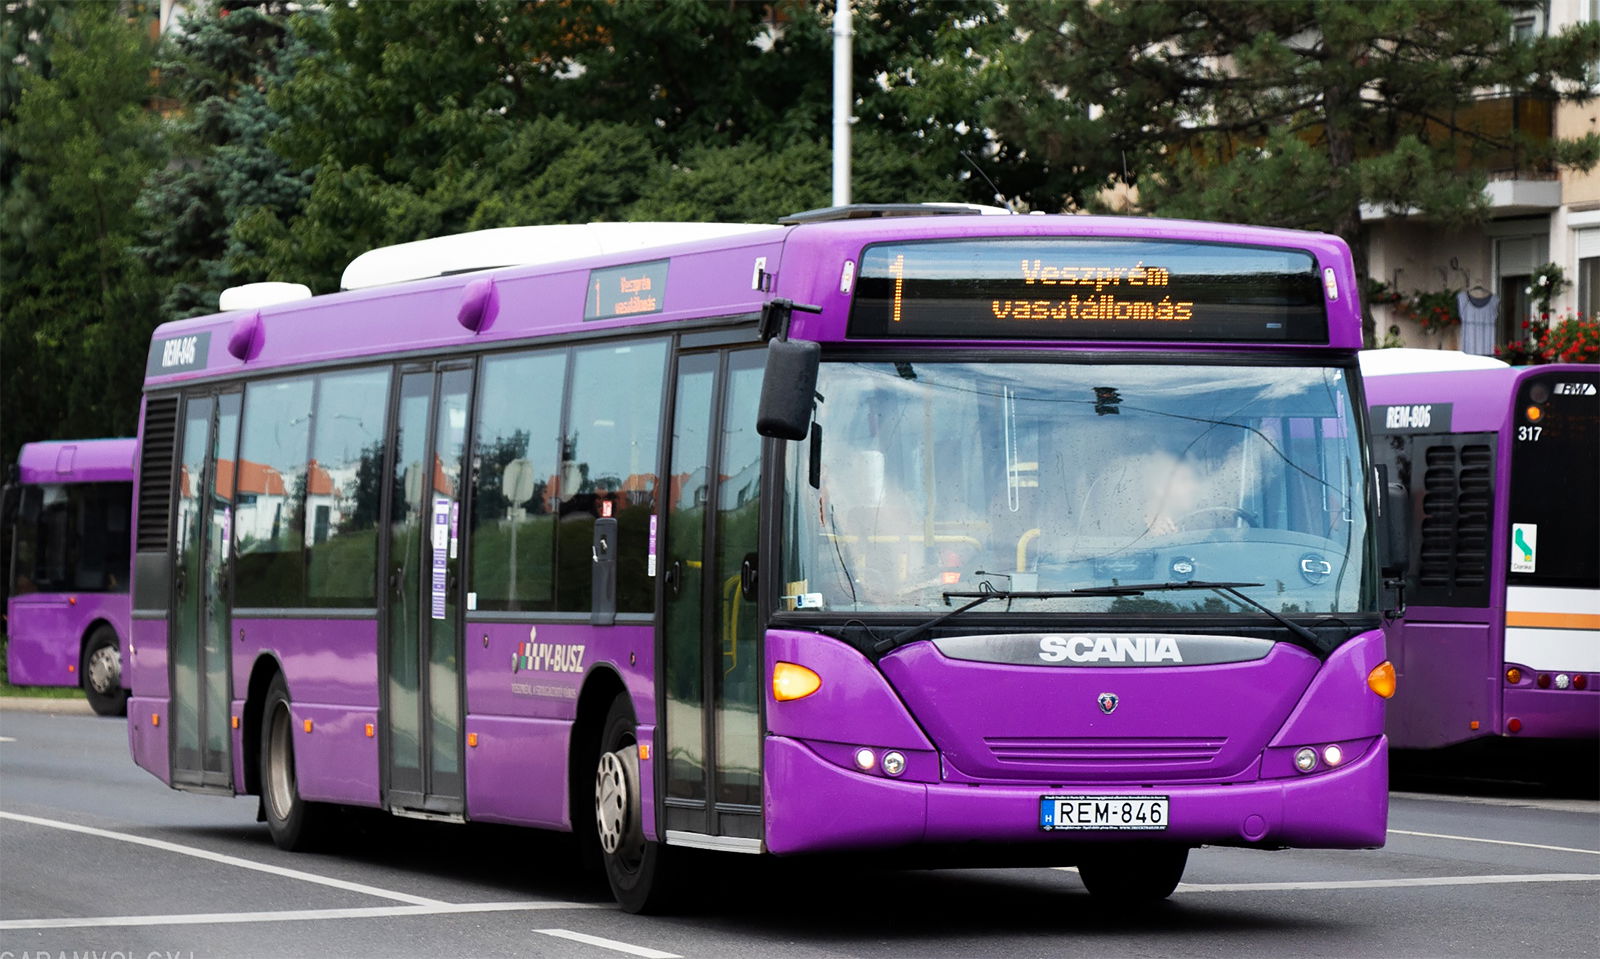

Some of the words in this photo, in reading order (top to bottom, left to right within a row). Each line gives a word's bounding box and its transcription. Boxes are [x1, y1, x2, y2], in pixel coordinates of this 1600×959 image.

[889, 254, 904, 322] 1
[1021, 259, 1170, 293] Veszprém
[991, 295, 1195, 321] vasútállomás
[1386, 405, 1432, 429] REM-806
[1518, 426, 1542, 441] 317
[542, 644, 586, 673] V-BUSZ
[1039, 636, 1184, 663] SCANIA
[1045, 814, 1053, 823] H
[1059, 802, 1163, 823] REM-846
